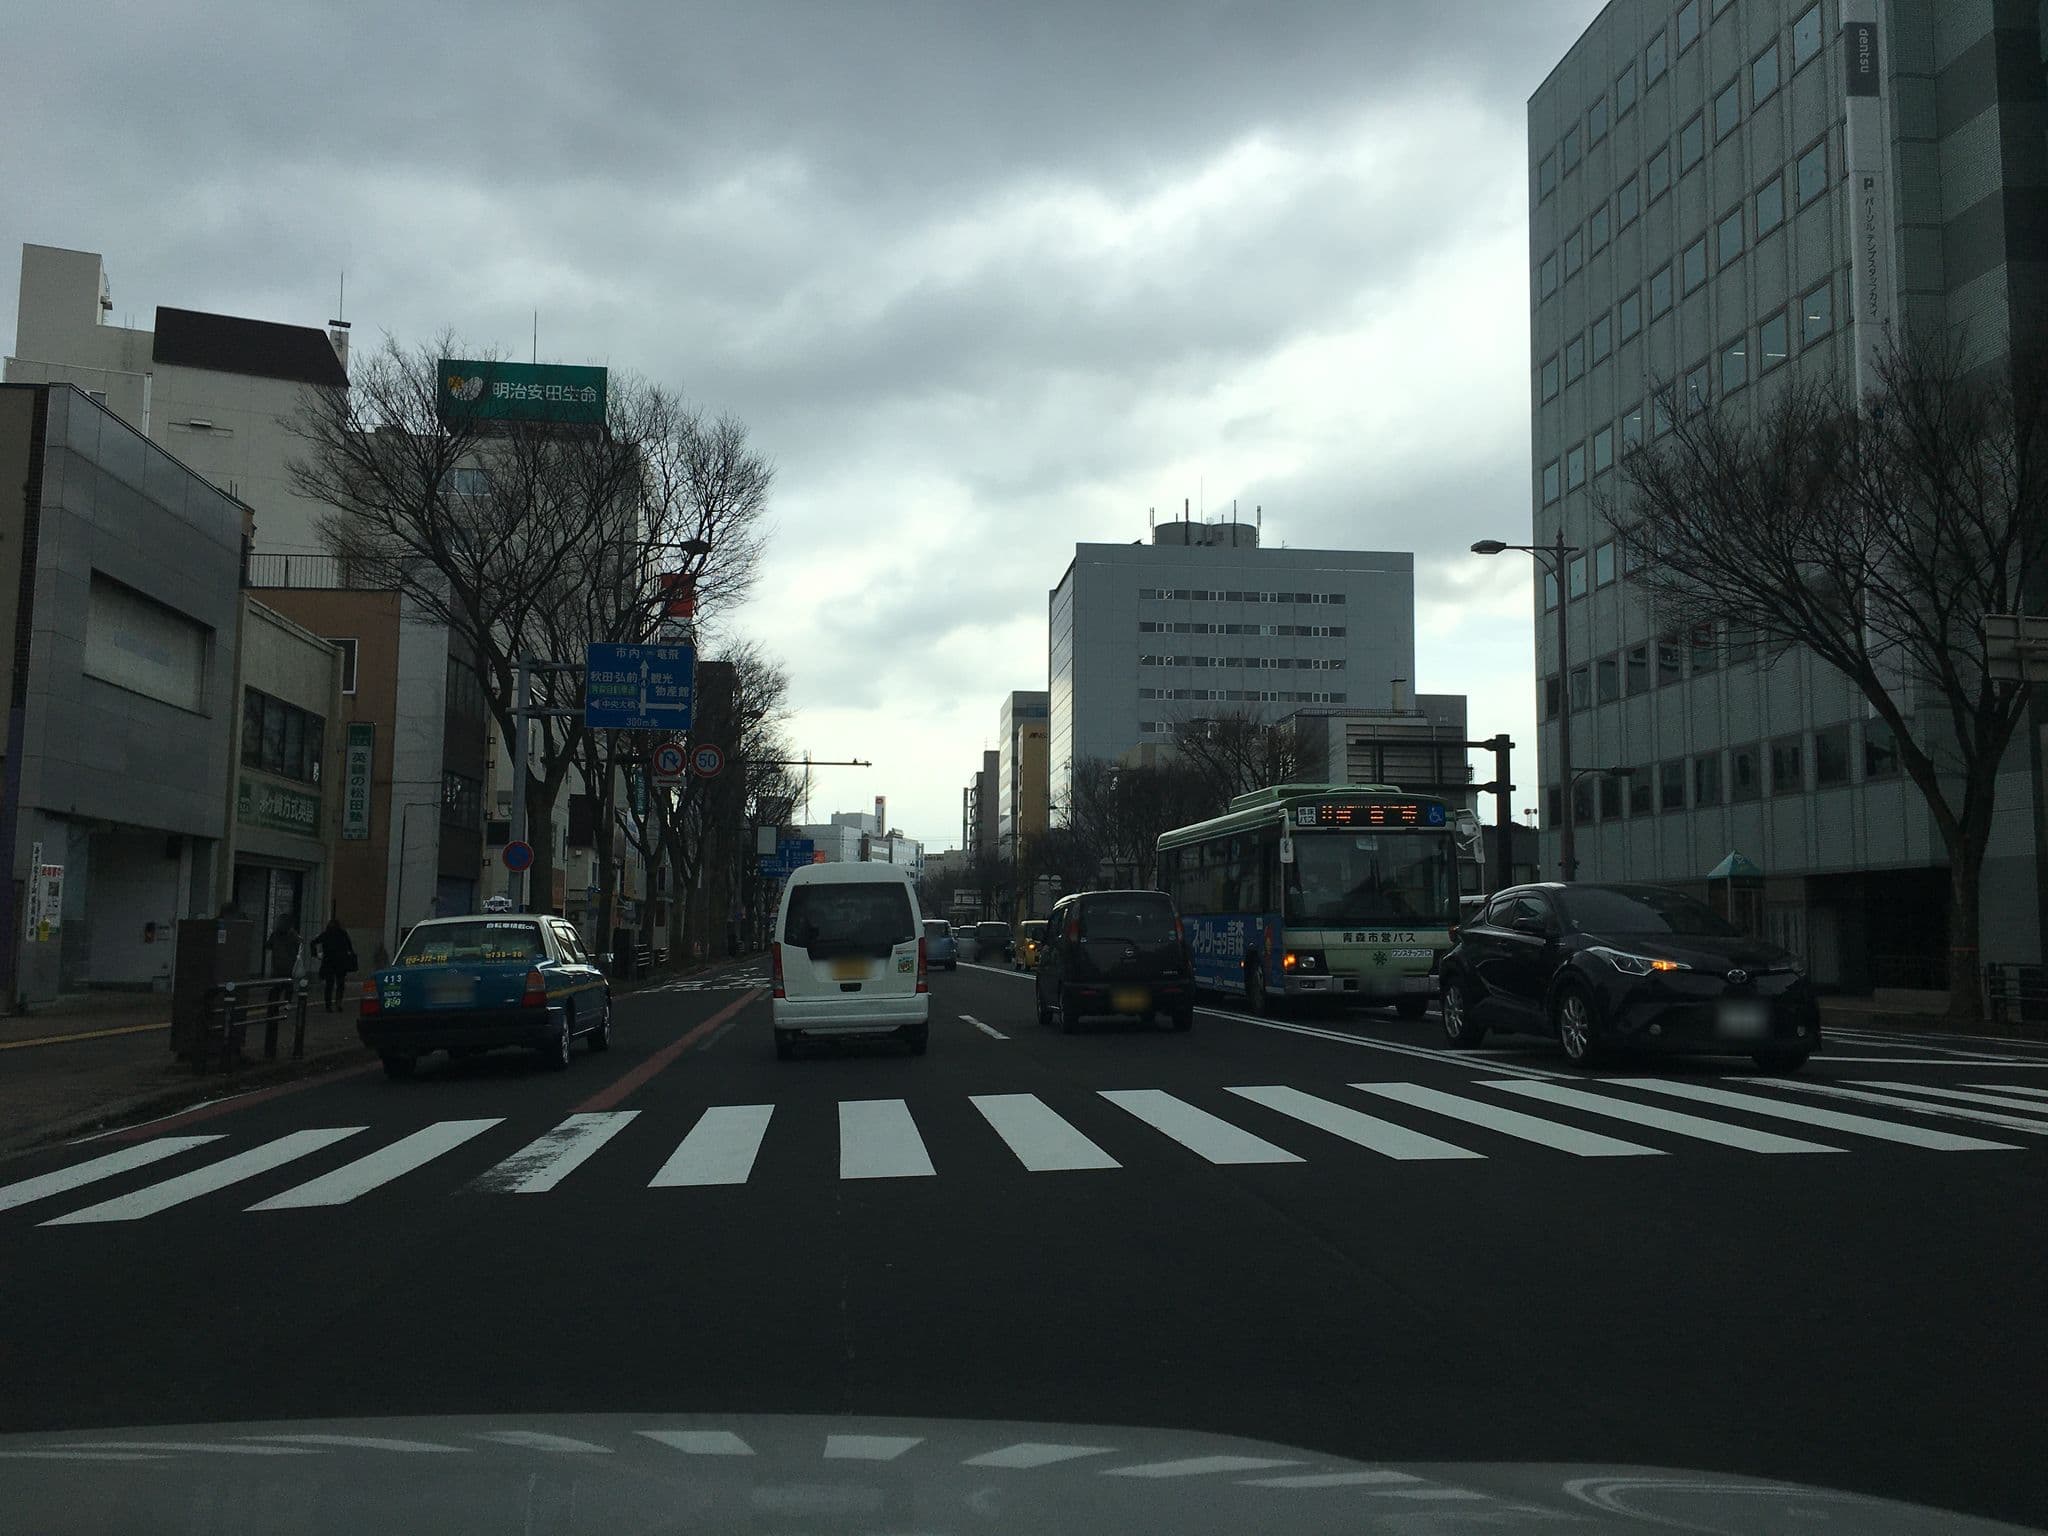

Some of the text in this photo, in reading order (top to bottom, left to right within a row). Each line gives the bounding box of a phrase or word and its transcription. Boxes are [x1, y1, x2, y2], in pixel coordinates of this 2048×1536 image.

[1858, 28, 1870, 73] dentsu
[492, 382, 598, 403] 明治安田生命
[615, 647, 640, 659] 市内
[698, 753, 717, 768] 50
[1343, 932, 1416, 943] 青森市営バス
[383, 974, 402, 983] 413
